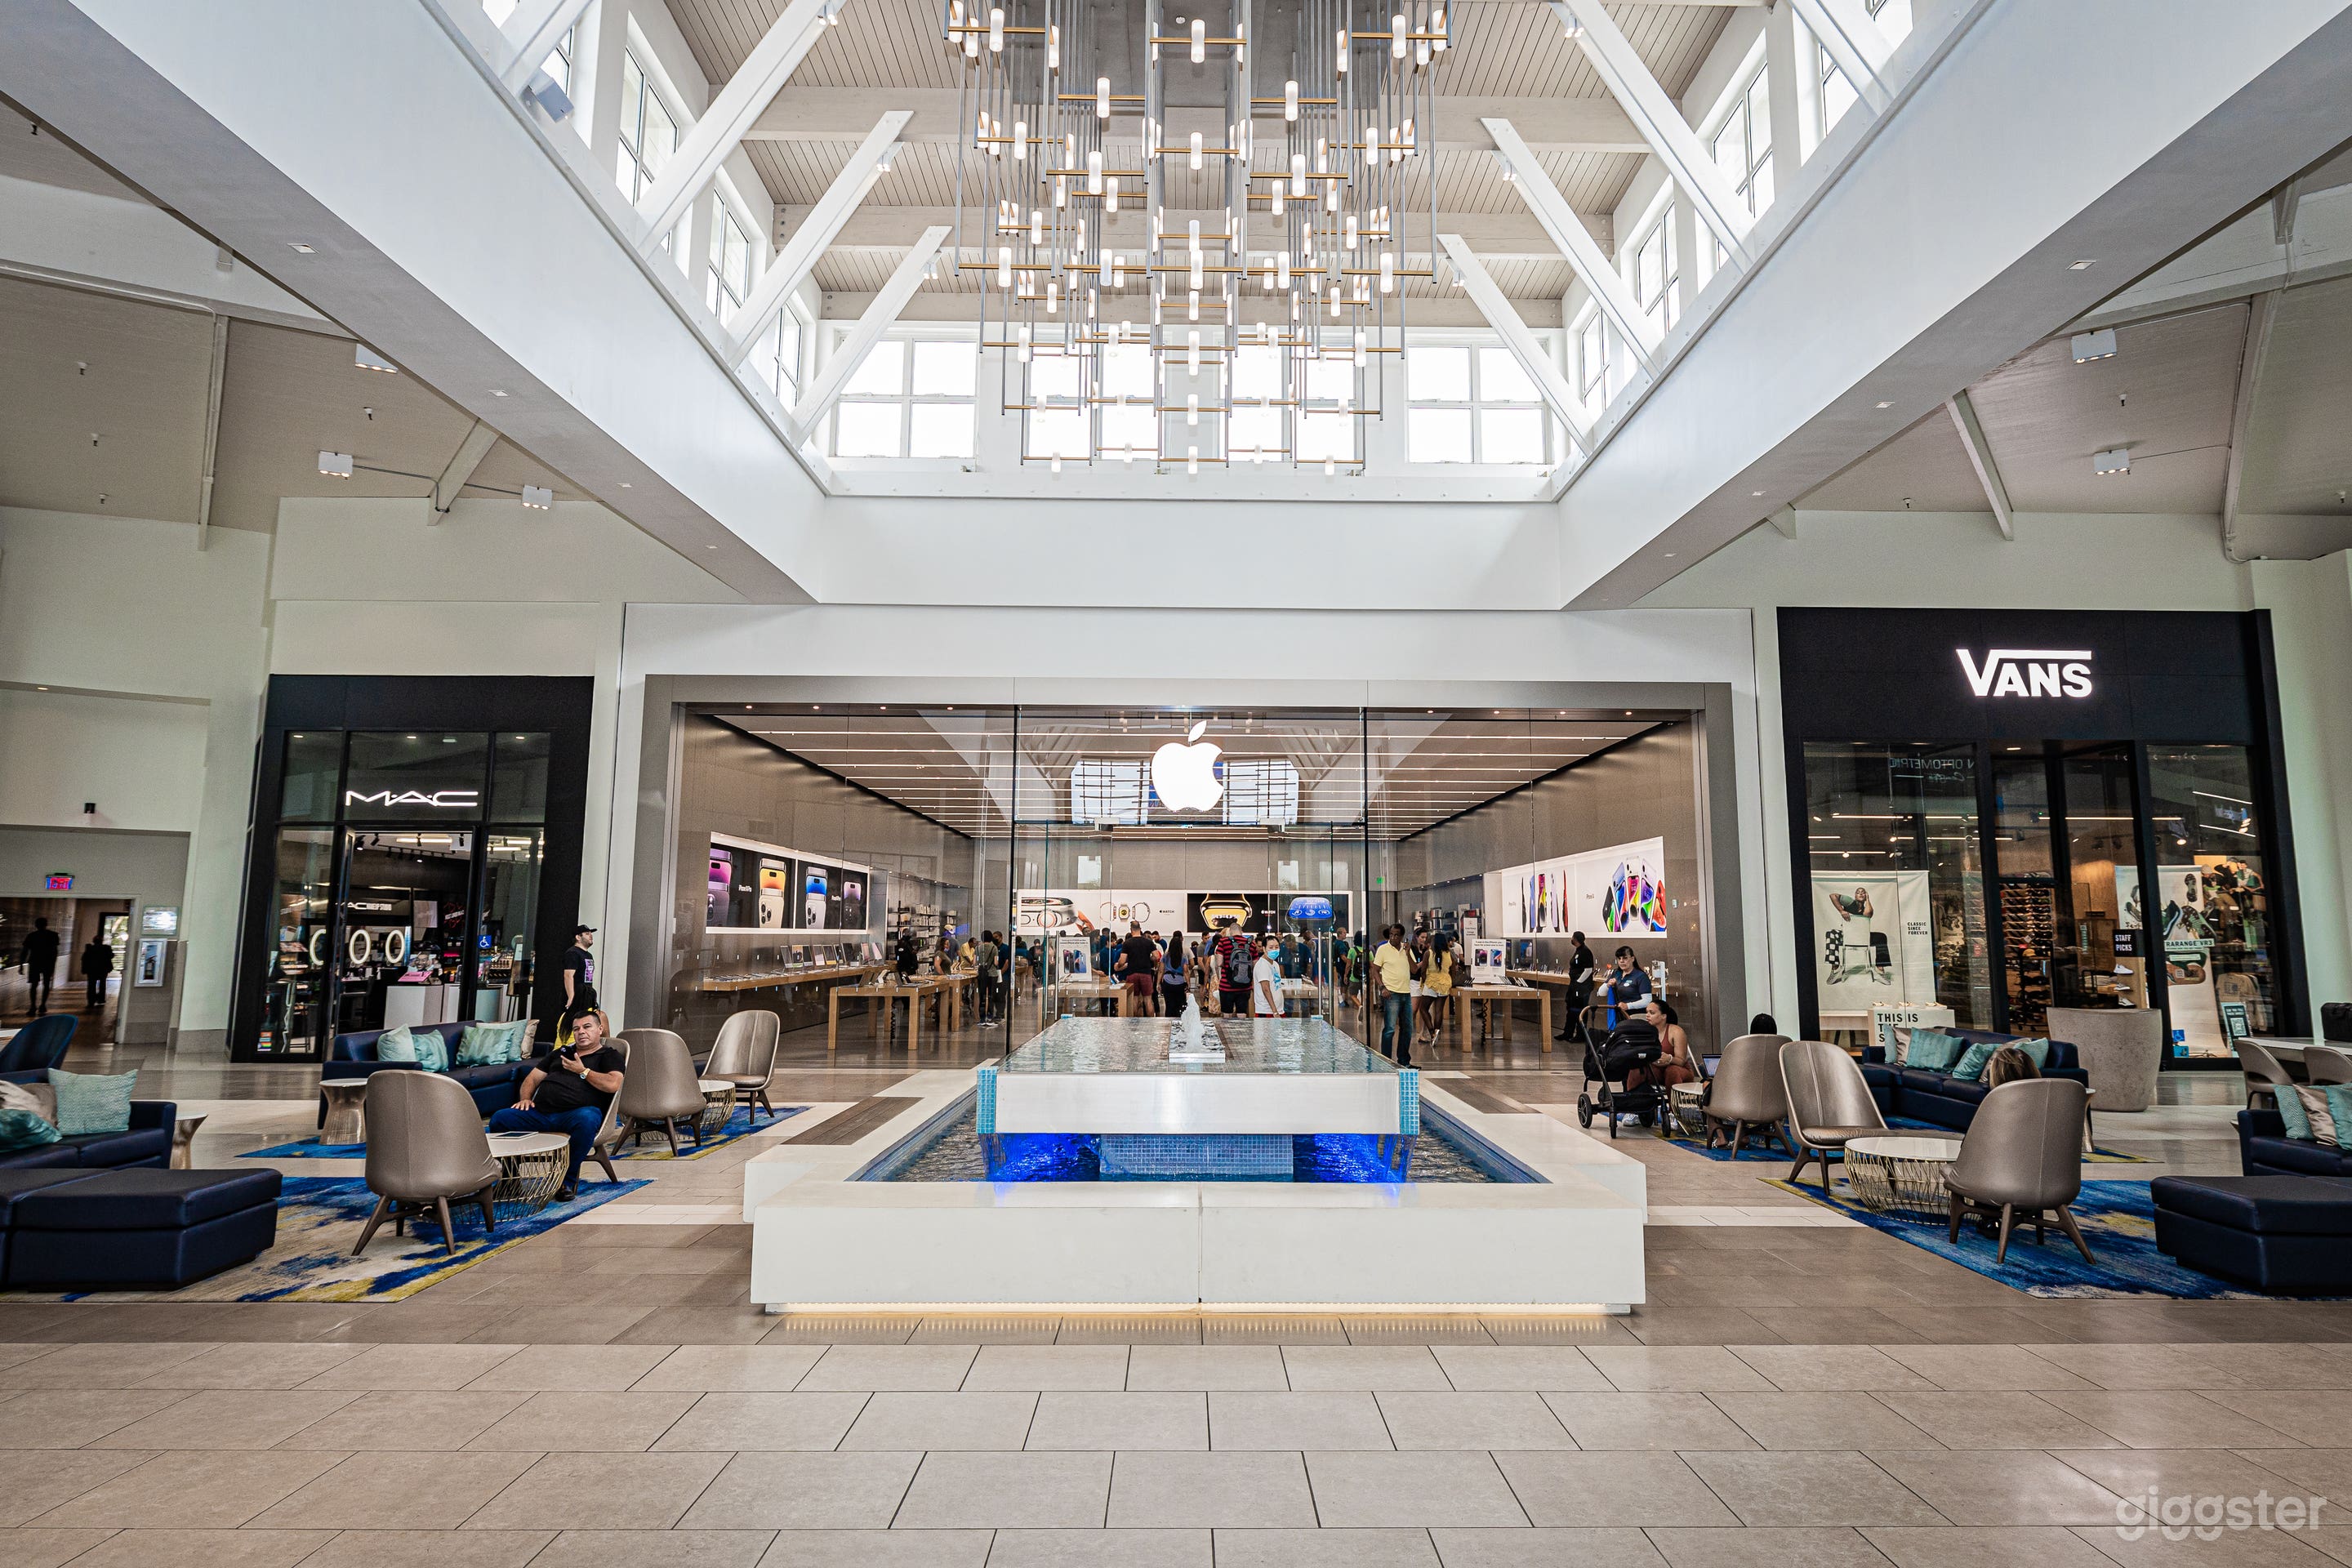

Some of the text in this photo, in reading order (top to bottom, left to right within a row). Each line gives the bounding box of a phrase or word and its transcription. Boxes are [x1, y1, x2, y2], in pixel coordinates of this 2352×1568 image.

[1956, 649, 2092, 697] VANS
[1878, 1013, 1918, 1022] THIS IS
